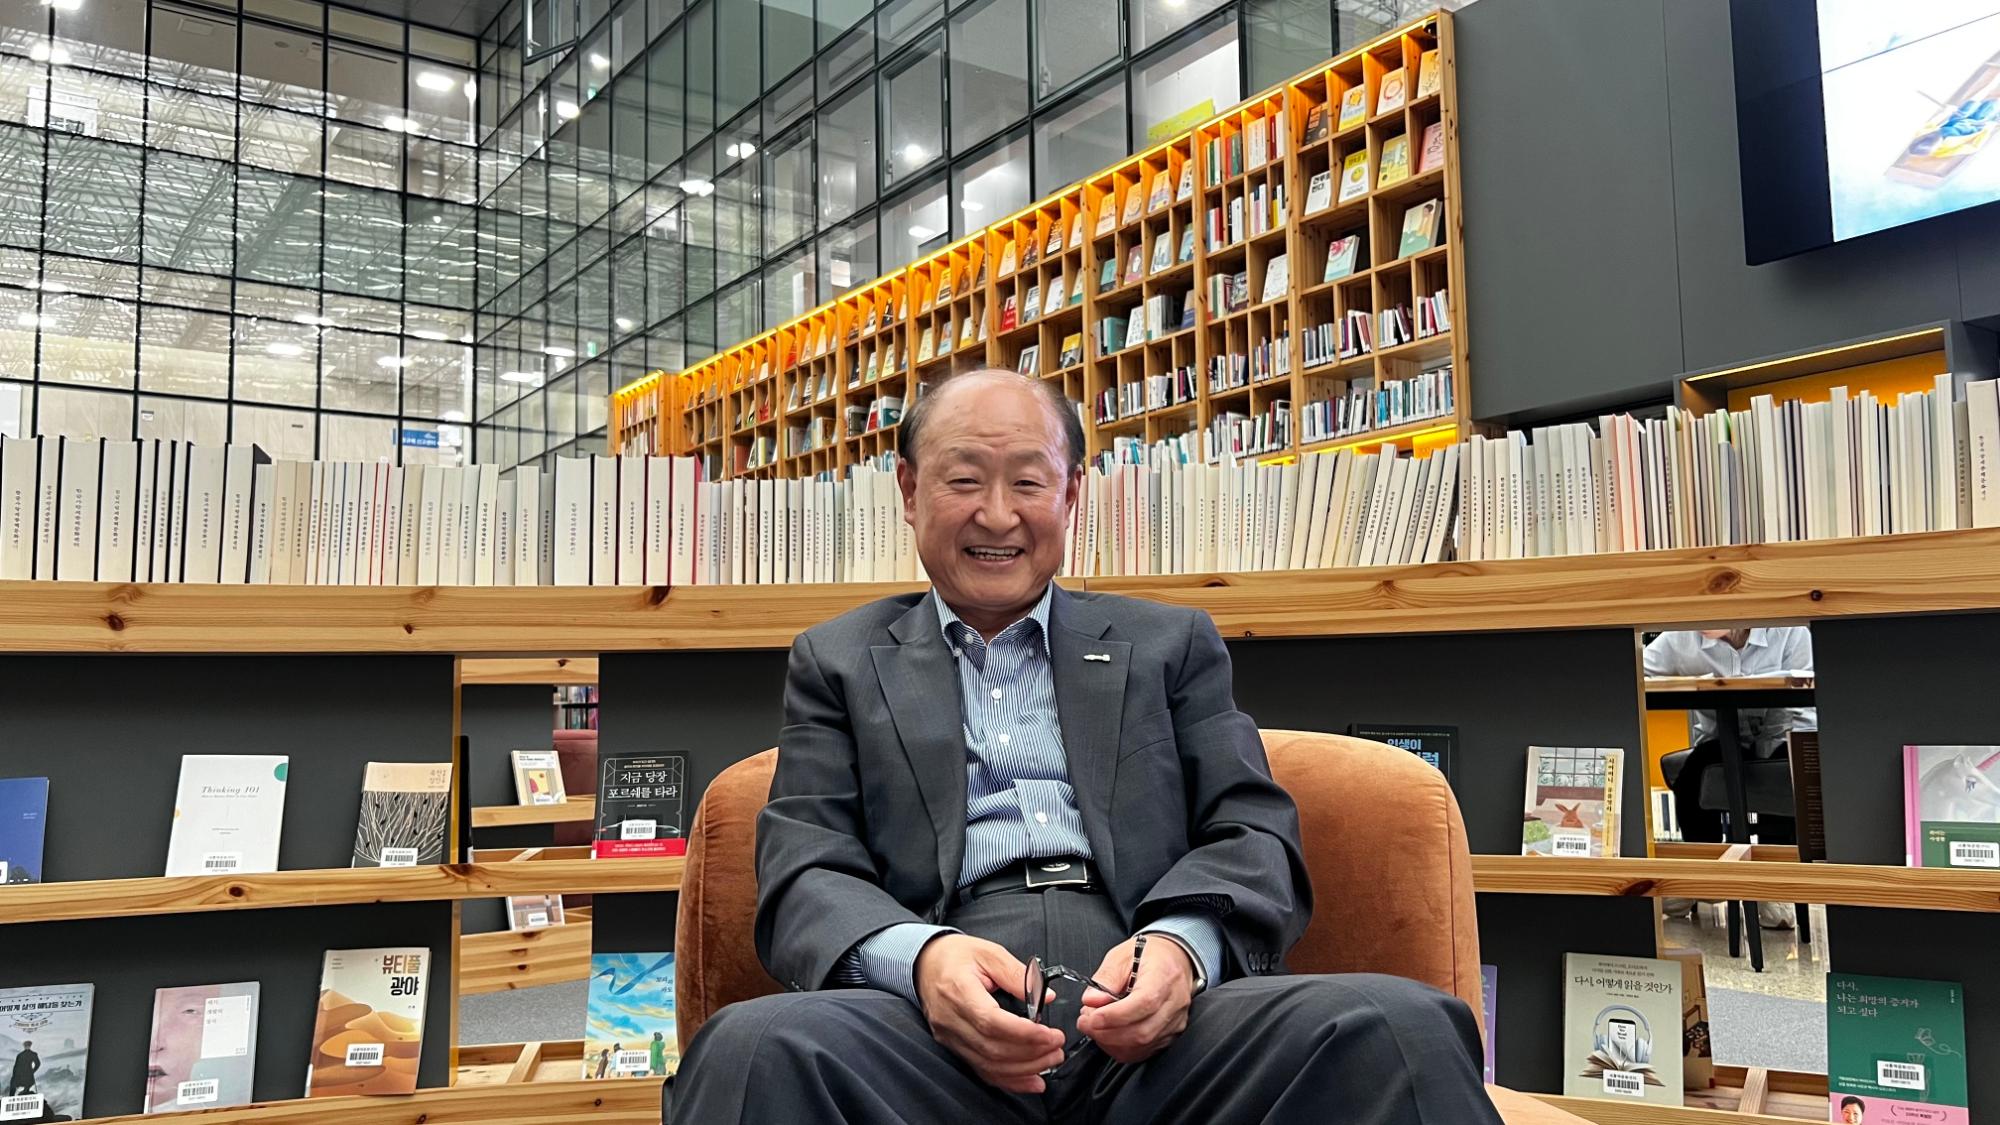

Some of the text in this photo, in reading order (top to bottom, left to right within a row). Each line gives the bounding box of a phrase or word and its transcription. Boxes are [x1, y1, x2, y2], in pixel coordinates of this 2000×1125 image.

[620, 770, 668, 784] 지금 당장
[202, 785, 241, 795] Thinking
[608, 785, 678, 799] 포르쉐를 타라
[382, 954, 421, 975] 뷰티풀
[390, 976, 420, 996] 광야
[1574, 976, 1673, 994] 다시, 어떻게 읽을 것인가
[1836, 980, 1859, 991] 다시,
[37, 1001, 59, 1009] 해답을
[60, 1000, 82, 1008] 찾는가
[1836, 993, 1920, 1009] 나는 희망의 증거가
[1837, 1005, 1878, 1017] 되고 싶다
